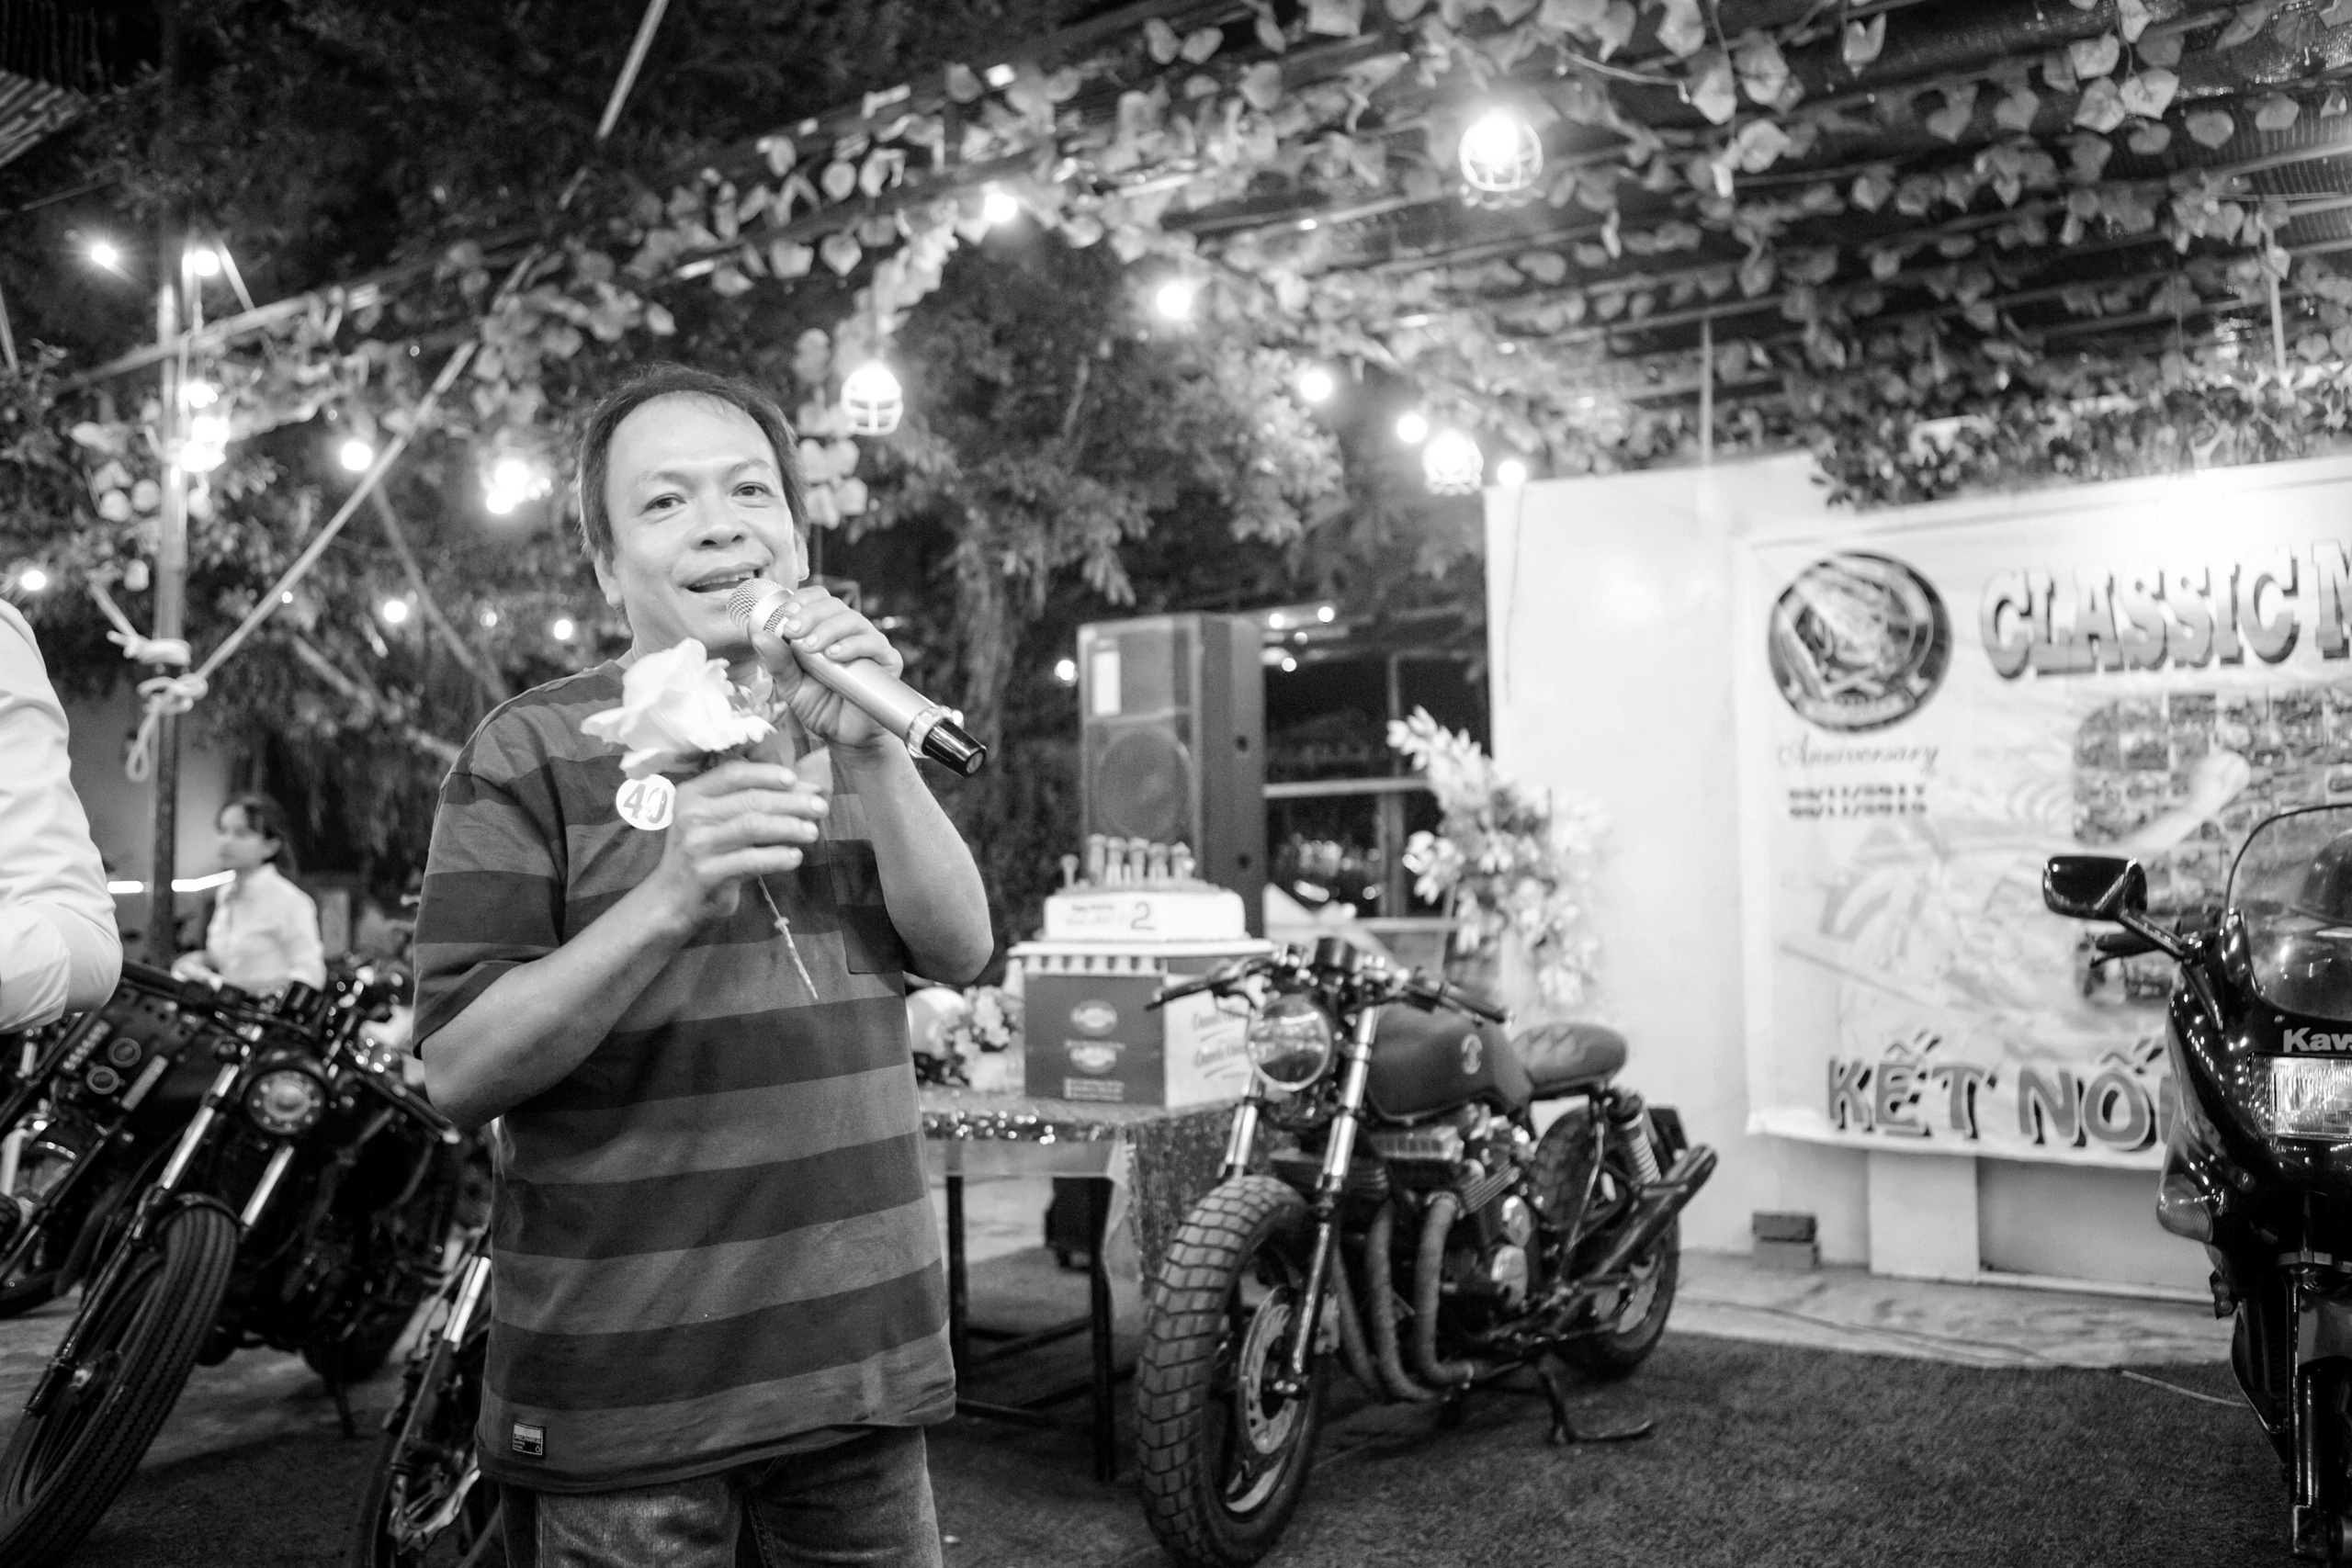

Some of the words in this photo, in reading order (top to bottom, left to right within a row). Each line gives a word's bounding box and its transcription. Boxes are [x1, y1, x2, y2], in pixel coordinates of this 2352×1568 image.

[1982, 546, 2300, 679] CLASSIC
[623, 784, 668, 824] 40
[1130, 900, 1156, 931] 2
[1826, 1029, 1998, 1140] KẾT
